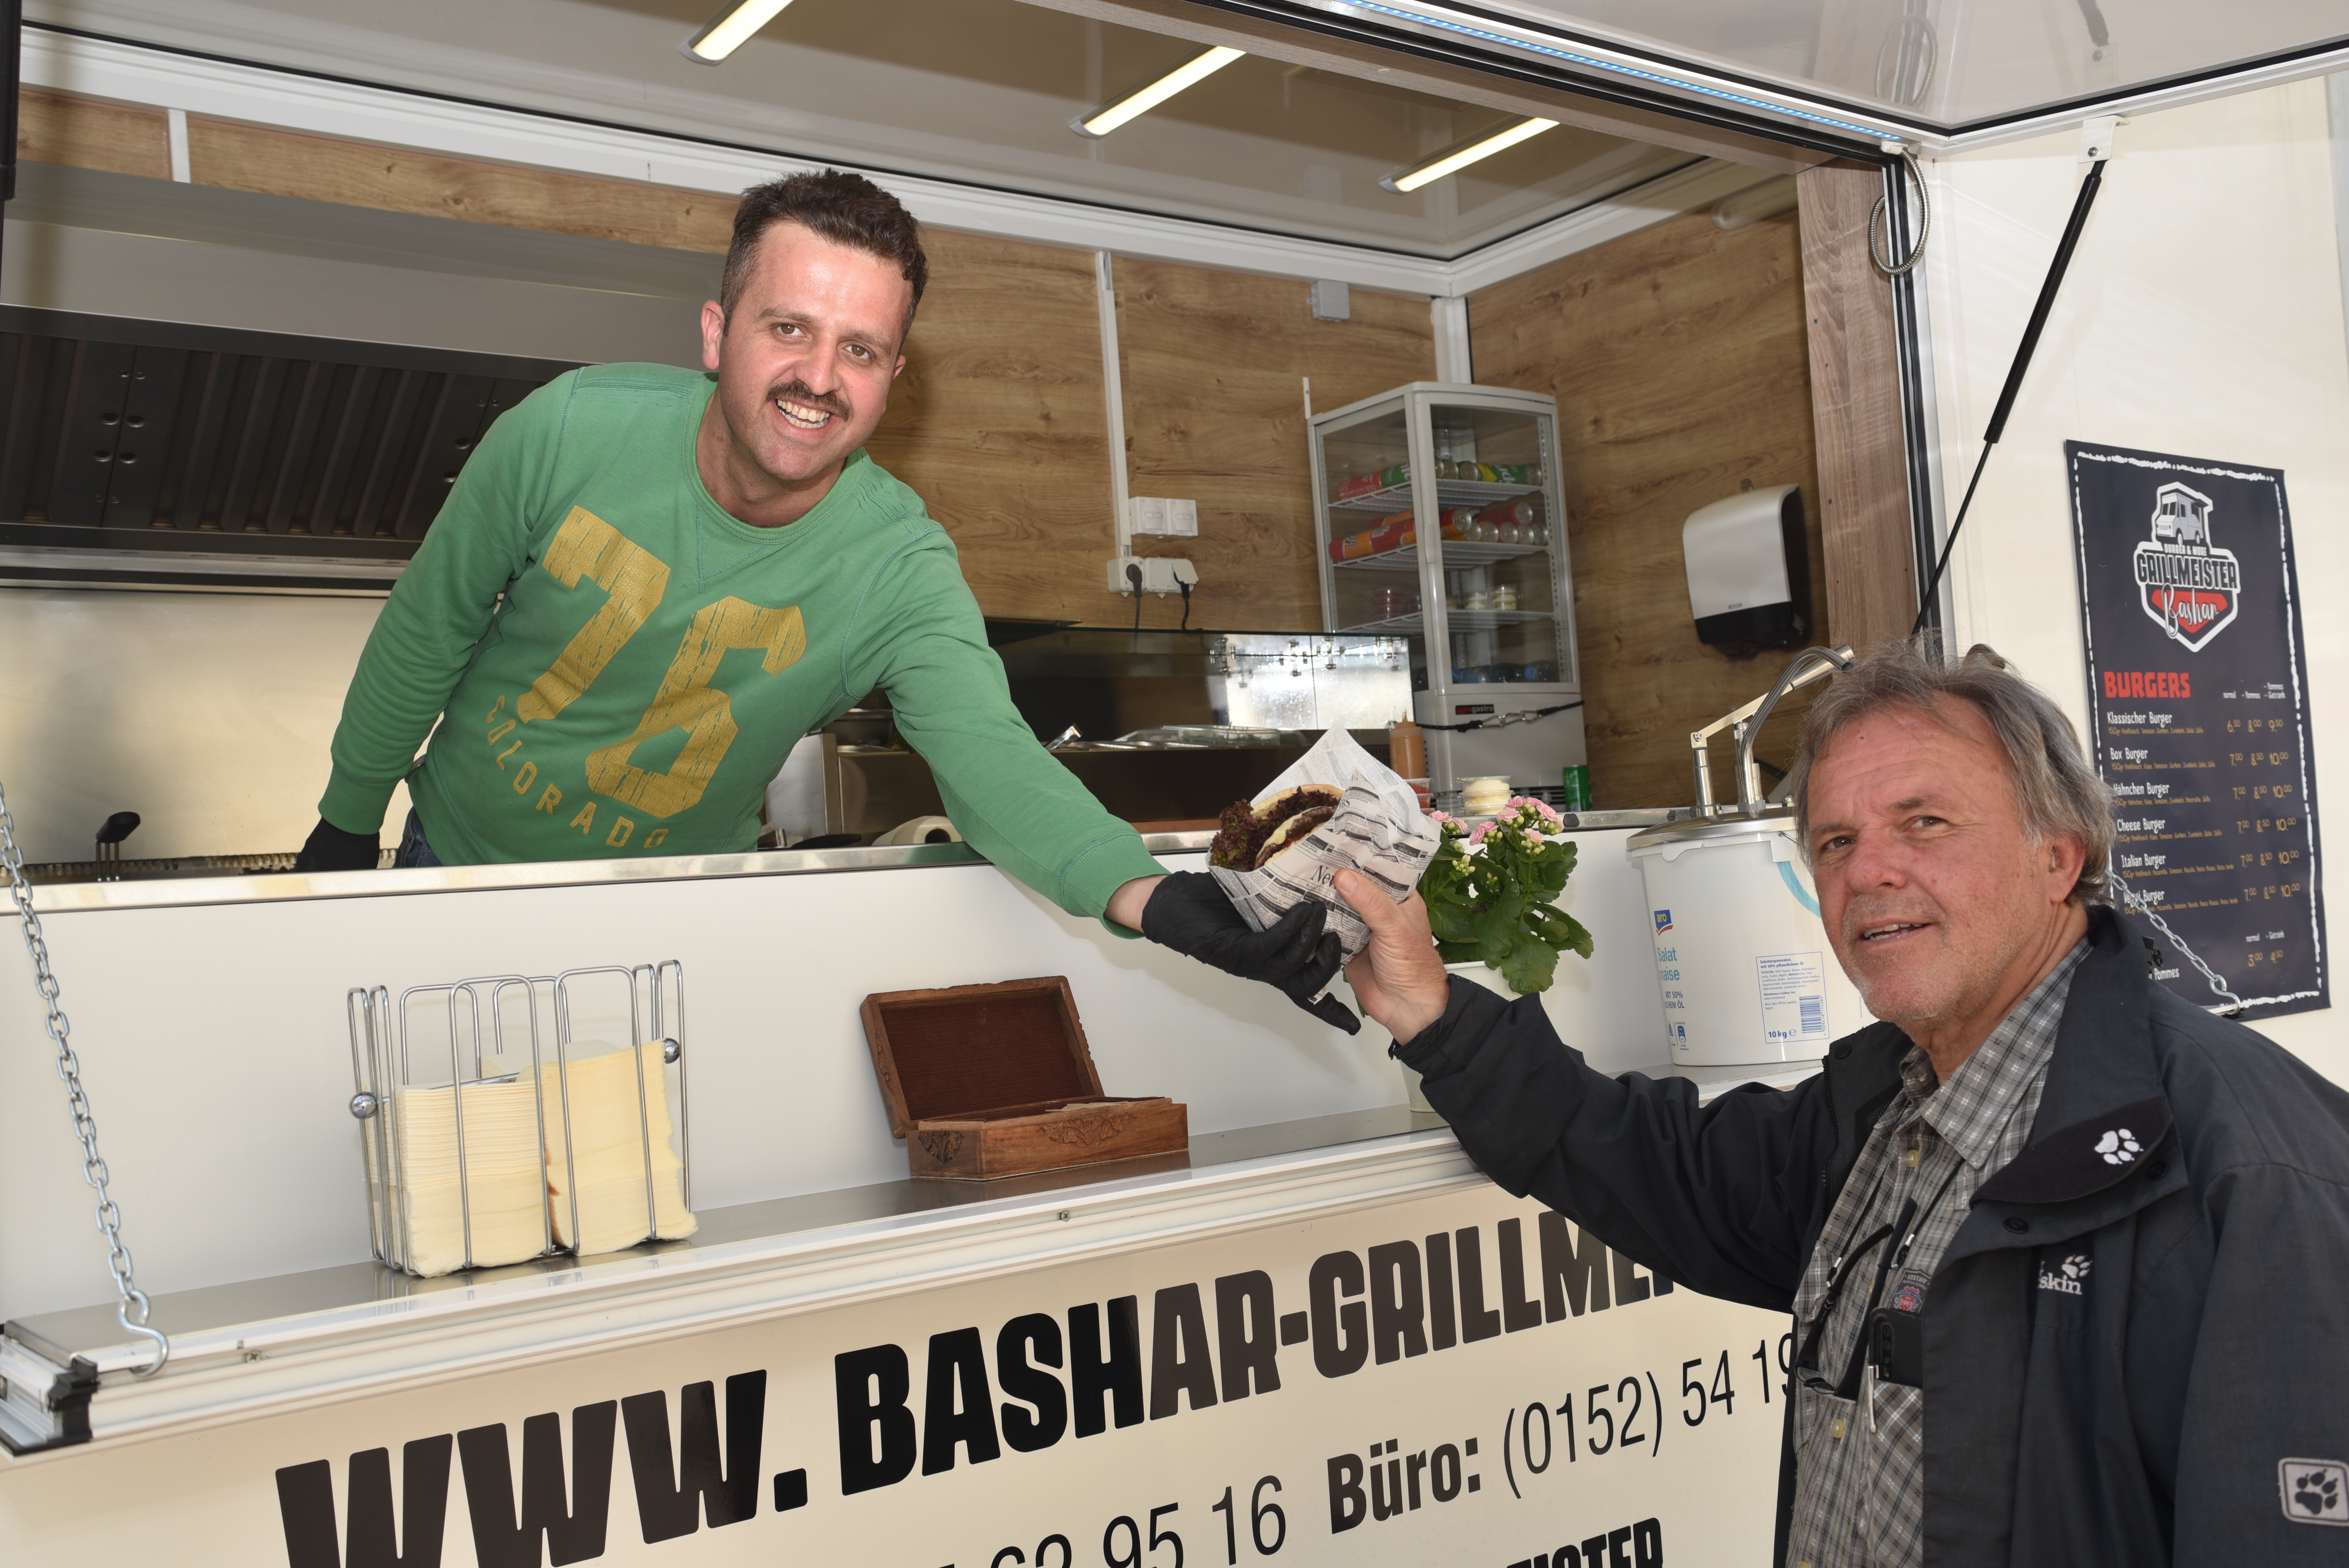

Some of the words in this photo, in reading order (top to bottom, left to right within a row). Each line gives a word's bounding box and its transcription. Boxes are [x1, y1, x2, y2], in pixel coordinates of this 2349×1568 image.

[2164, 543, 2185, 554] BURGER
[2192, 546, 2207, 556] MORE
[2136, 552, 2238, 590] GRILLMEISTER
[2162, 583, 2219, 639] Bashar
[2104, 672, 2191, 698] BURGERS
[2107, 711, 2146, 724] Klassischer
[2149, 711, 2172, 728] Burger
[2110, 747, 2123, 760] Box
[2125, 747, 2148, 764] Burger
[2113, 782, 2144, 796] Hähnchen
[2147, 782, 2169, 798] Burger
[2117, 819, 2140, 831] Cheese
[2143, 818, 2165, 834] Burger
[1399, 848, 1416, 857] OBSTETRICS
[2121, 854, 2142, 868] Italian
[2144, 853, 2166, 869] Burger
[2143, 889, 2165, 905] Burger
[1657, 913, 1667, 923] aro
[2246, 933, 2260, 943] normal
[1657, 947, 1677, 962] Salat
[2154, 968, 2180, 980] Pommes
[1677, 1000, 1684, 1009] ÖL
[1778, 1030, 1787, 1039] kg
[1899, 1299, 1913, 1308] 1993
[1103, 1502, 1184, 1568] 95
[1212, 1474, 1287, 1566] 16
[1327, 1436, 1481, 1535] Büro:
[1503, 1371, 1662, 1500] (0152)
[1682, 1349, 1735, 1427] 54
